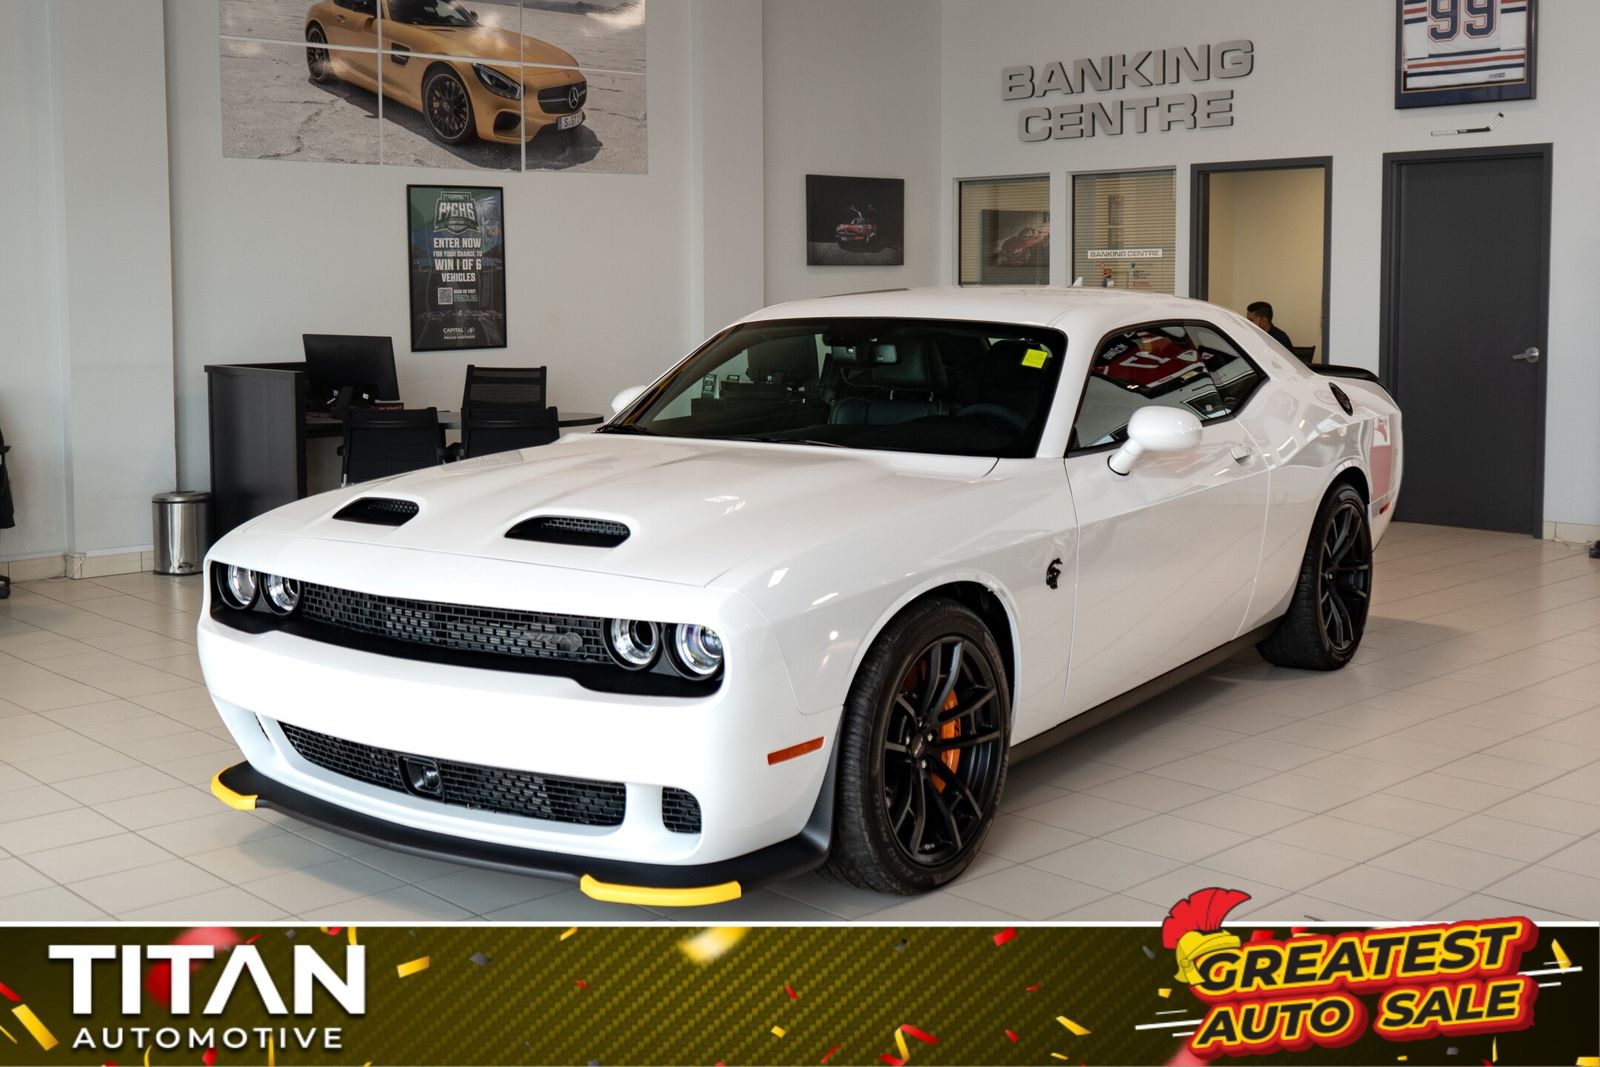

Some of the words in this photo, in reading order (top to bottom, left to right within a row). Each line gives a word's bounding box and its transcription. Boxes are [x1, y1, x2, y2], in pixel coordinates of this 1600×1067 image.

[1001, 39, 1254, 101] BANKING
[1018, 89, 1234, 142] CENTRE
[433, 237, 460, 248] ENTER
[462, 237, 482, 248] NOW
[1090, 250, 1126, 258] BANKING
[1127, 249, 1160, 257] CENTRE
[434, 258, 454, 270] WIN
[462, 258, 473, 270] OF
[475, 258, 482, 270] 6
[441, 272, 476, 282] VEHICLES
